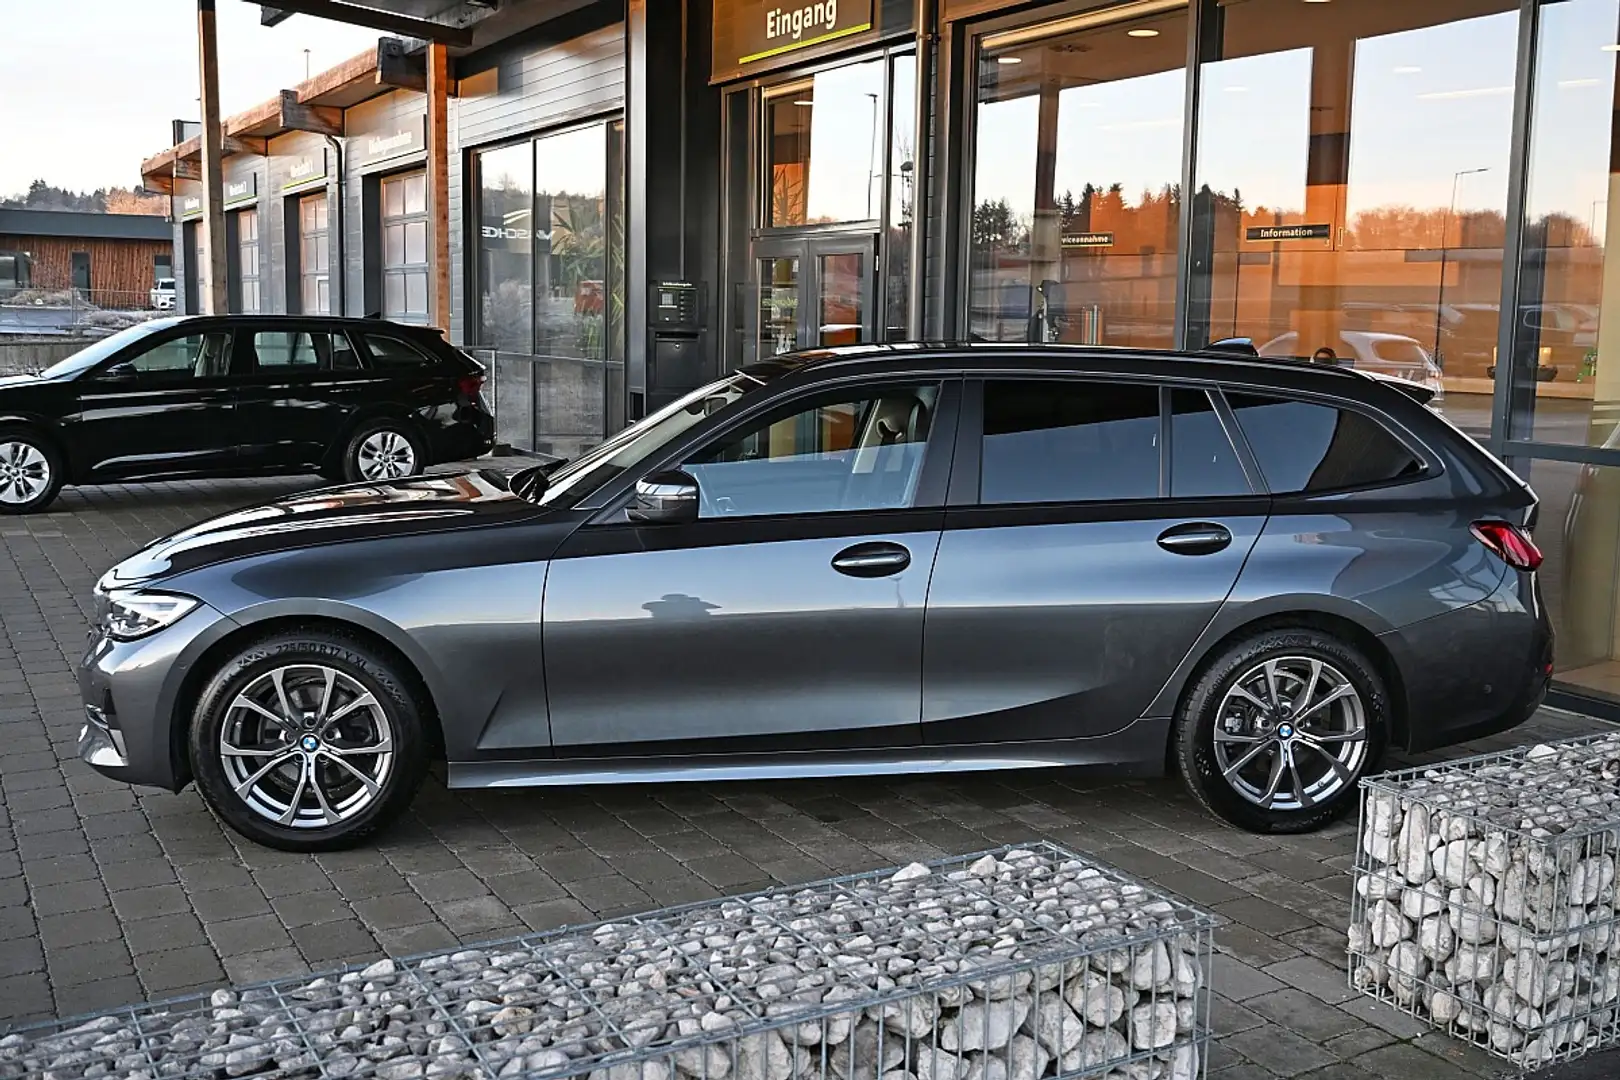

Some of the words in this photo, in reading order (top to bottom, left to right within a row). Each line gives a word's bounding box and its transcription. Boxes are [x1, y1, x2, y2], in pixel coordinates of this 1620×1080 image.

[766, 0, 837, 39] Eingang
[1061, 235, 1108, 244] viceannahme
[1260, 227, 1313, 238] Information
[275, 641, 316, 654] 225/50
[354, 656, 367, 669] XL
